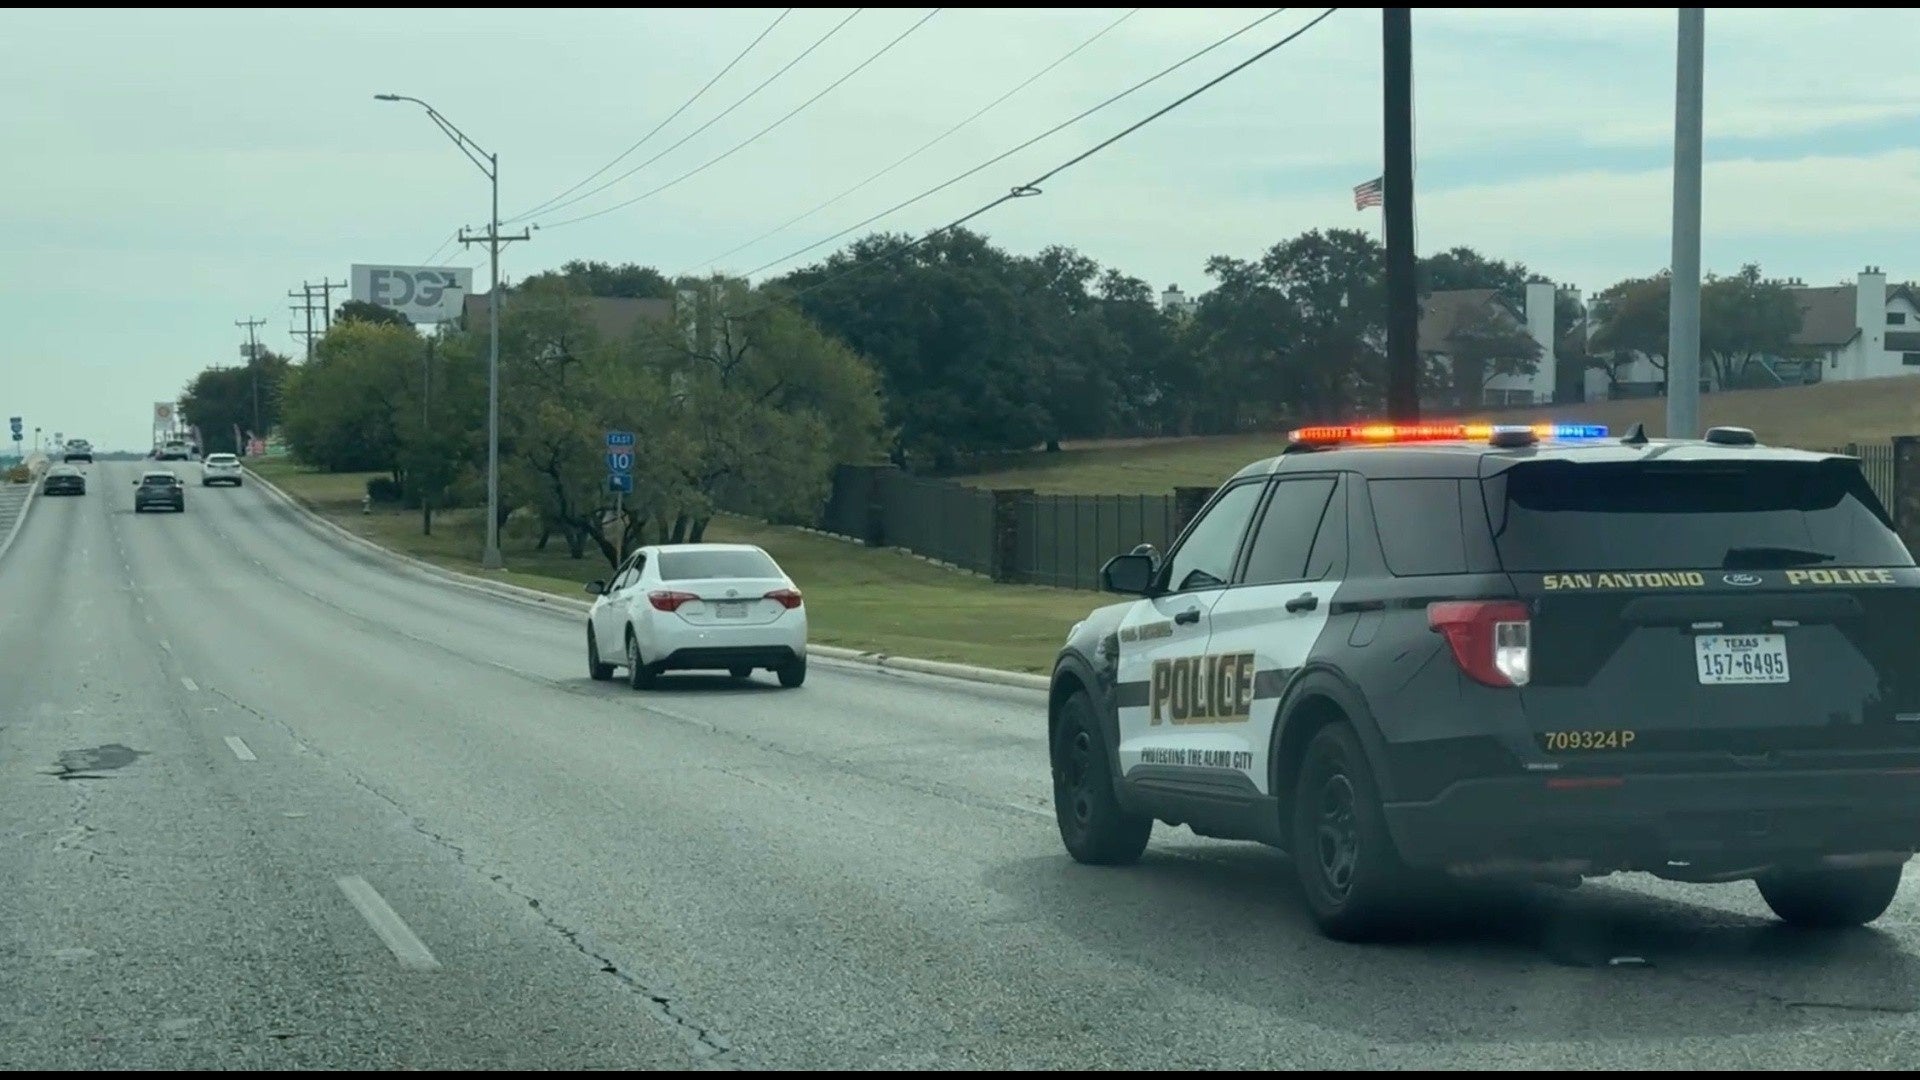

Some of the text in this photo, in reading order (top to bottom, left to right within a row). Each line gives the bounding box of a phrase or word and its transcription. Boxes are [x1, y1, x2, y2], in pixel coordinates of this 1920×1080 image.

[370, 269, 455, 307] EDG
[612, 453, 629, 469] 10
[1543, 571, 1705, 590] SAN ANTONIO
[1785, 568, 1896, 585] POLICE
[1724, 638, 1759, 648] TEXAS
[1150, 651, 1255, 725] POLICE
[1187, 749, 1202, 766] THE
[1204, 750, 1232, 768] ALAMO
[1233, 751, 1253, 770] CITY
